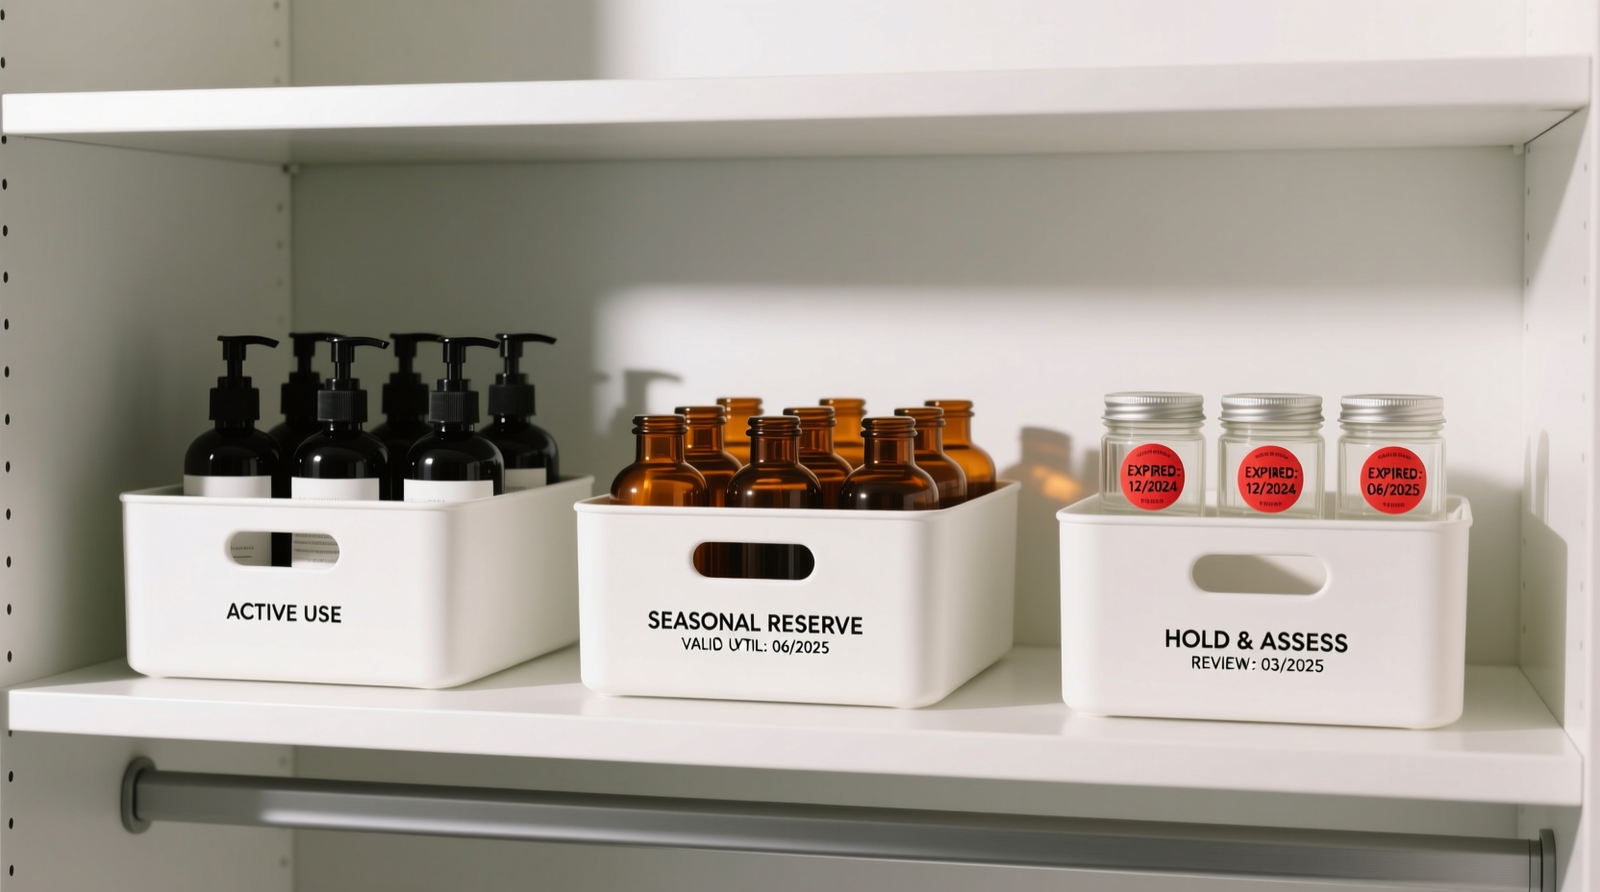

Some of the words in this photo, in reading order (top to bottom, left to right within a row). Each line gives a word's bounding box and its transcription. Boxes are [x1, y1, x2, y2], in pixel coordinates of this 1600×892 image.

[1245, 466, 1298, 479] EXPIRED:
[1368, 467, 1423, 480] EXPIRED:
[1129, 480, 1177, 494] 12/2024
[1246, 482, 1296, 495] 12/2024
[1367, 483, 1420, 497] 06/2025
[226, 602, 298, 622] ACTIVE
[304, 605, 342, 624] USE
[648, 610, 762, 632] SEASONAL
[767, 613, 863, 635] RESERVE
[681, 636, 723, 652] VALID
[772, 639, 830, 655] 06/2025
[1165, 629, 1231, 649] HOLD
[1236, 631, 1254, 650] &
[1259, 631, 1349, 653] ASSESS
[1191, 655, 1257, 671] REVIEW:
[1261, 657, 1324, 673] 03/2025
